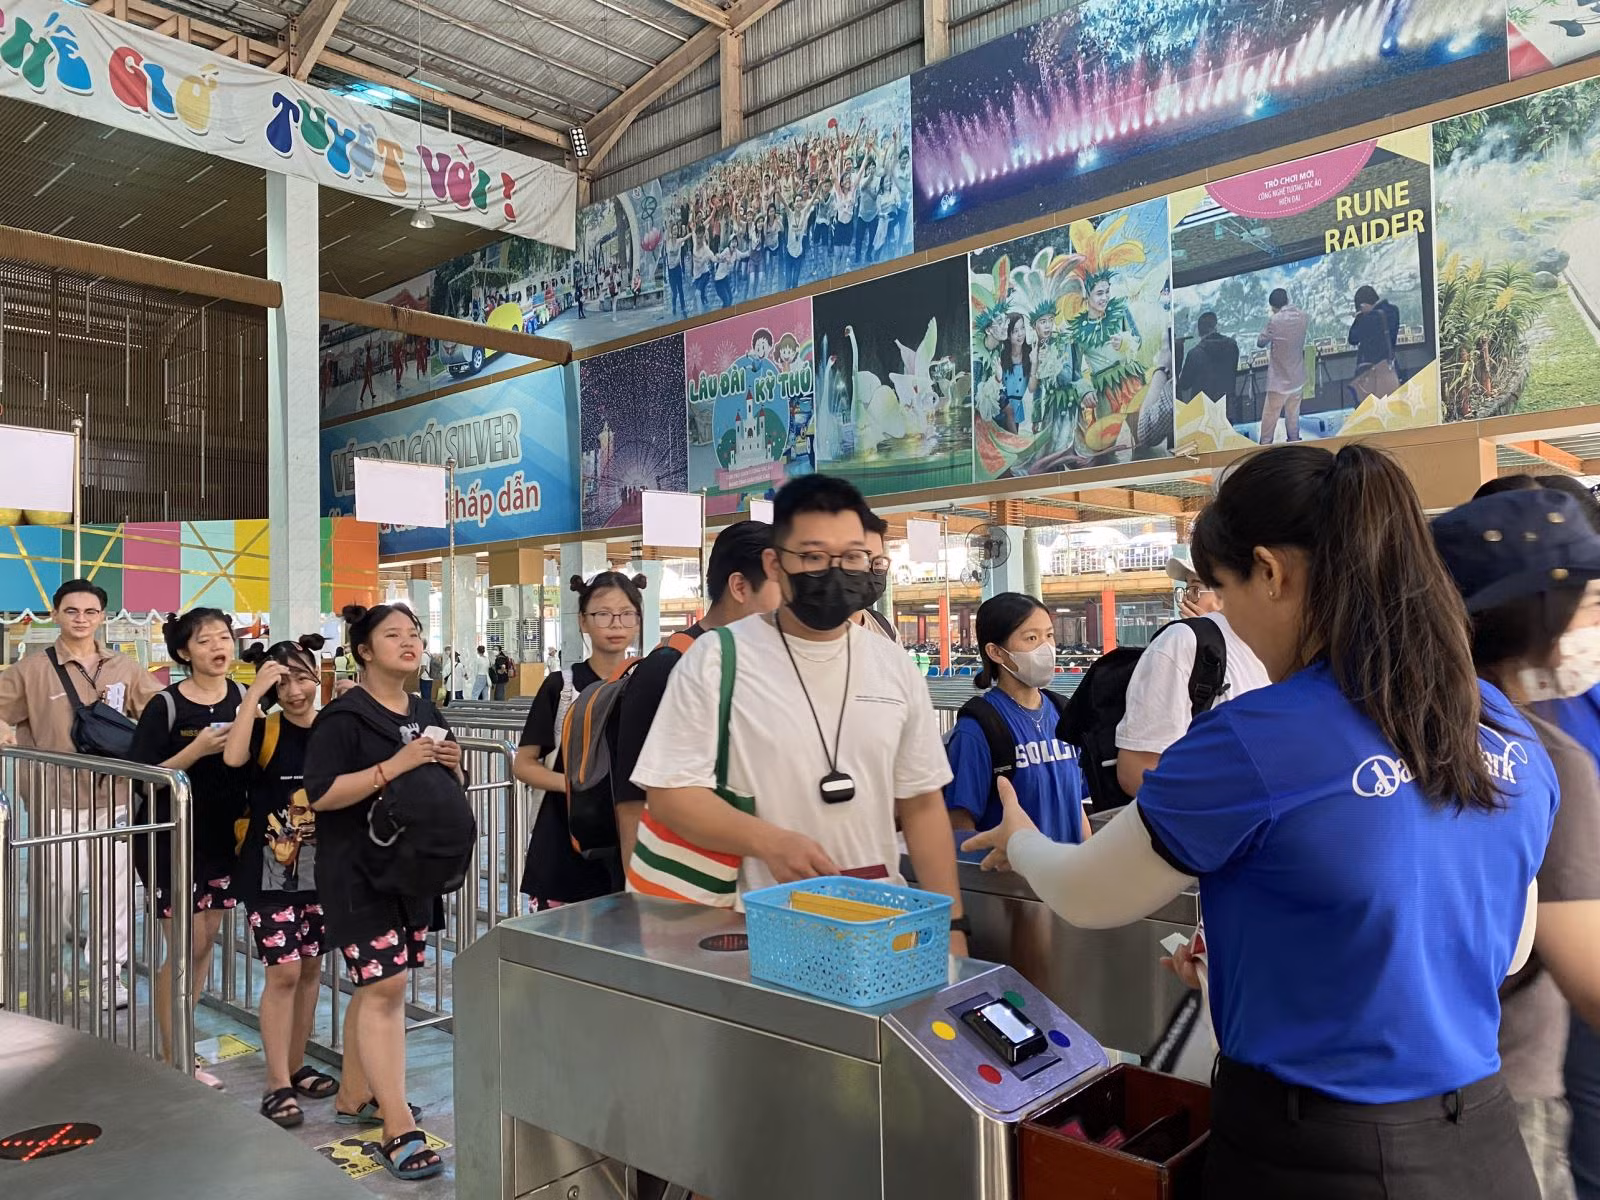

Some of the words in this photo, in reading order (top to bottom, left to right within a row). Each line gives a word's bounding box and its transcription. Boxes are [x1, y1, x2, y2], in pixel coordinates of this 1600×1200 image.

[0, 10, 92, 92] HẾ
[266, 91, 408, 197] TUYỆT
[1336, 180, 1409, 222] RUNE
[1324, 208, 1425, 254] RAIDER
[689, 370, 719, 403] LÂU
[719, 364, 746, 397] ĐÀI
[754, 370, 776, 403] KỲ
[777, 361, 812, 399] THÚ
[445, 413, 519, 468] SILVER
[455, 482, 493, 523] hấp
[499, 474, 539, 513] dẫn
